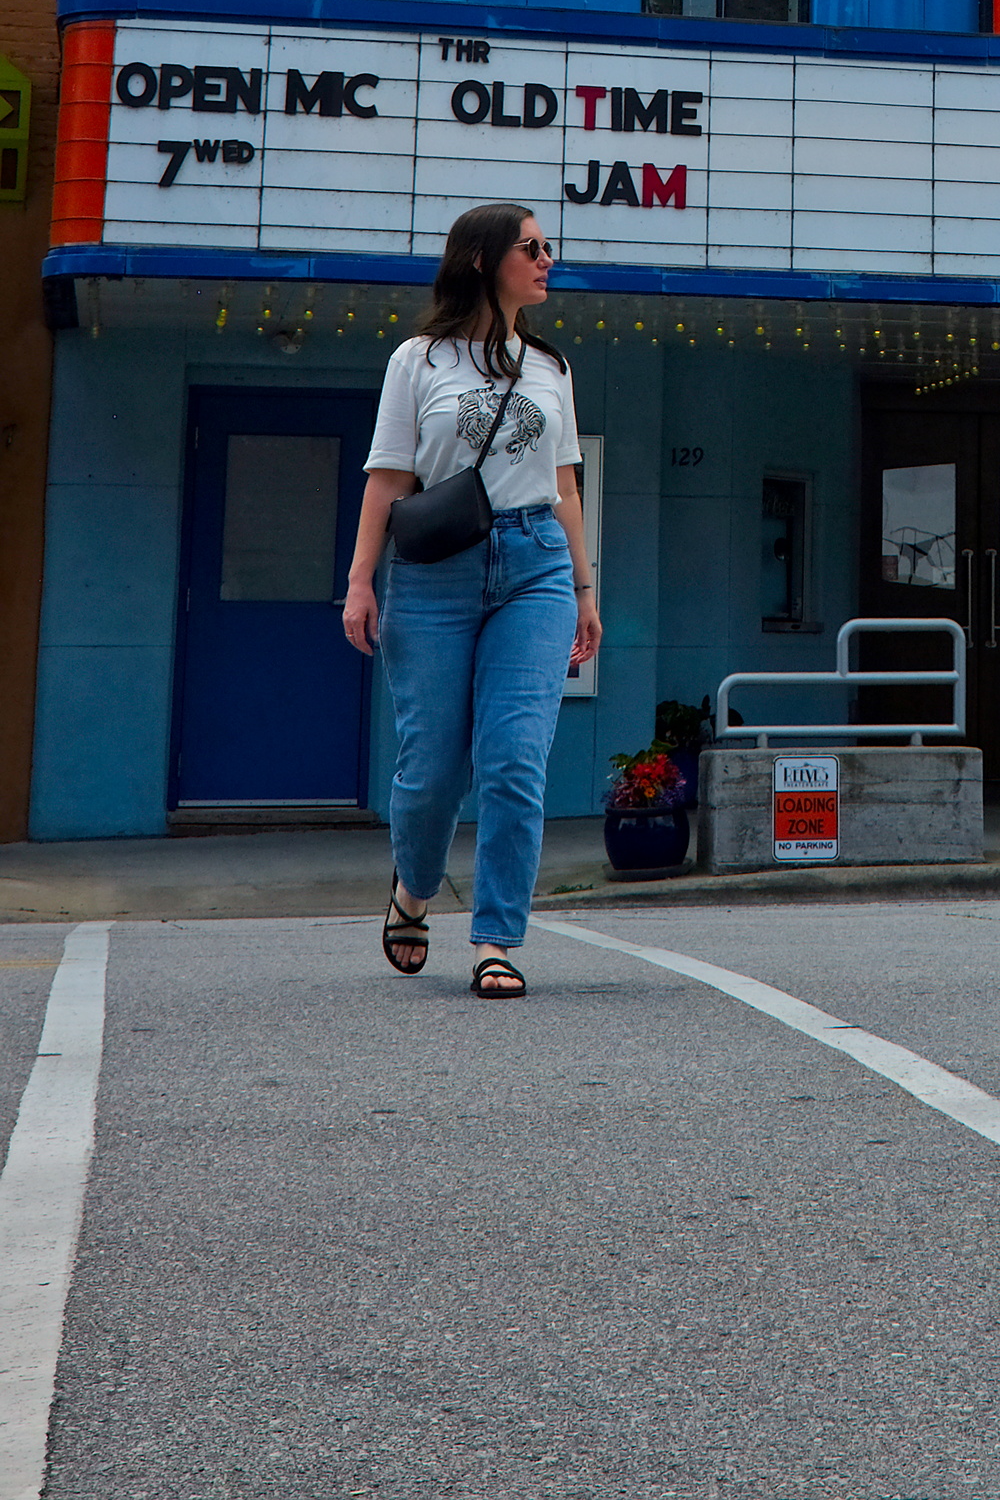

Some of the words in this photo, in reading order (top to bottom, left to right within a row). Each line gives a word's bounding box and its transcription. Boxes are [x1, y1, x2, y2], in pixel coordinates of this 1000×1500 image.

[438, 37, 491, 64] THR
[115, 61, 263, 115] OPEN
[284, 68, 380, 119] MIC
[451, 79, 558, 129] OLD
[574, 84, 704, 137] TIME
[564, 159, 687, 210] JAM
[671, 447, 704, 467] 129
[777, 797, 835, 814] LOADING
[788, 819, 825, 834] ZONE
[778, 842, 792, 850] NO
[796, 841, 833, 850] PARKING
